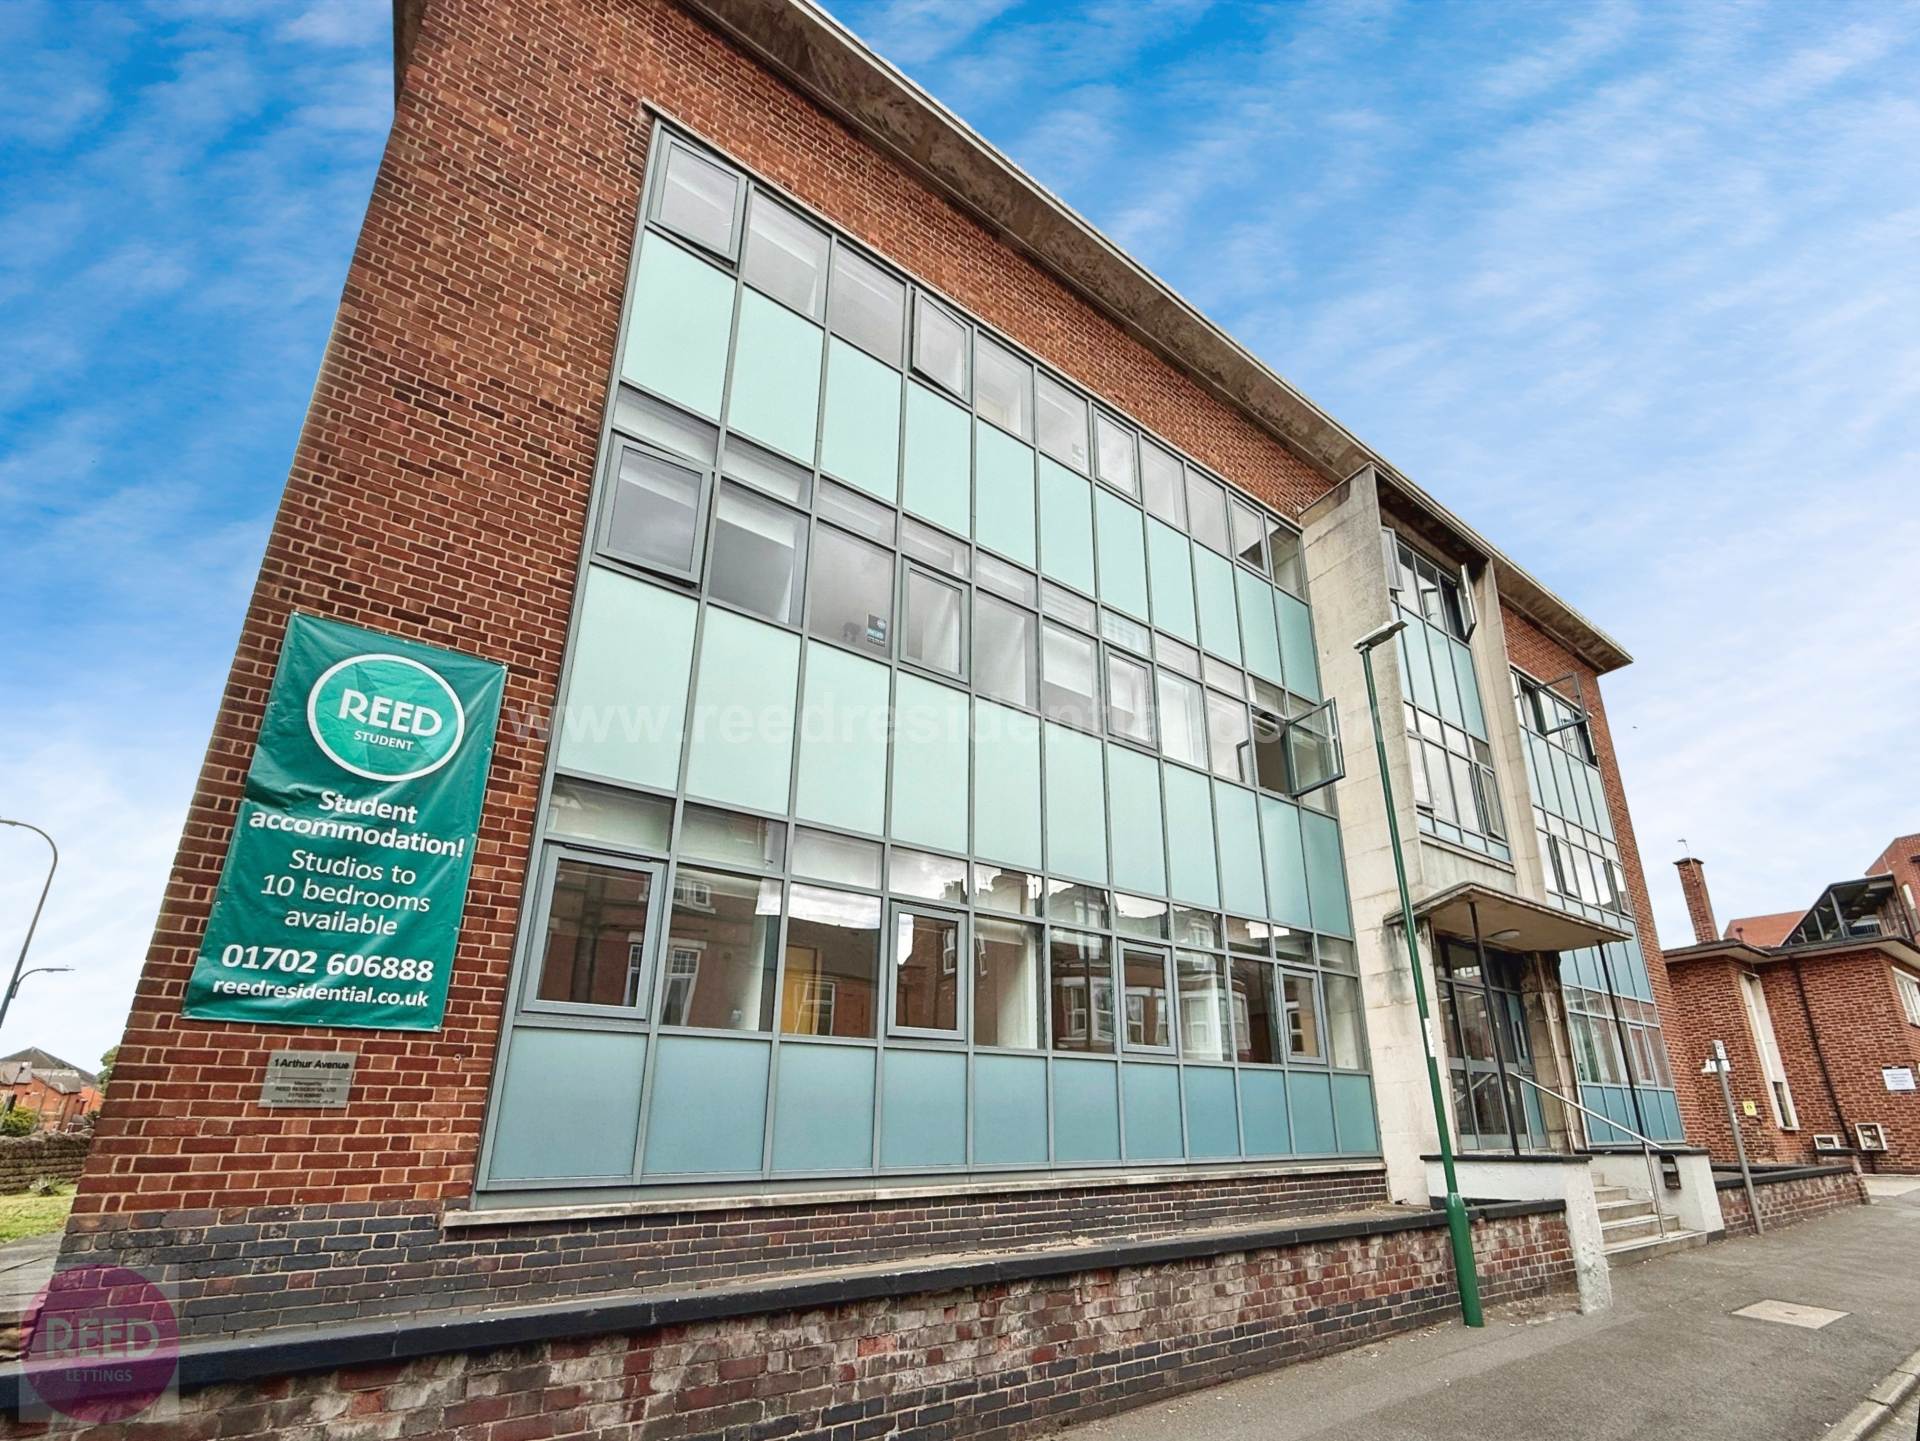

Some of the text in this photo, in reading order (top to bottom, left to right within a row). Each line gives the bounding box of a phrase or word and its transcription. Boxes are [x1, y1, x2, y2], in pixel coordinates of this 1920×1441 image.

[338, 688, 443, 737] REED
[353, 730, 414, 751] STUDENT
[318, 790, 418, 824] Student
[249, 811, 465, 858] accommodation!
[289, 849, 417, 885] Studios to
[260, 874, 431, 912] 10 bedrooms
[284, 909, 397, 936] available
[221, 944, 434, 982] 01702 606888
[212, 979, 429, 1007] reedresidential.co.uk
[274, 1058, 350, 1069] 1 Arthur Avenue
